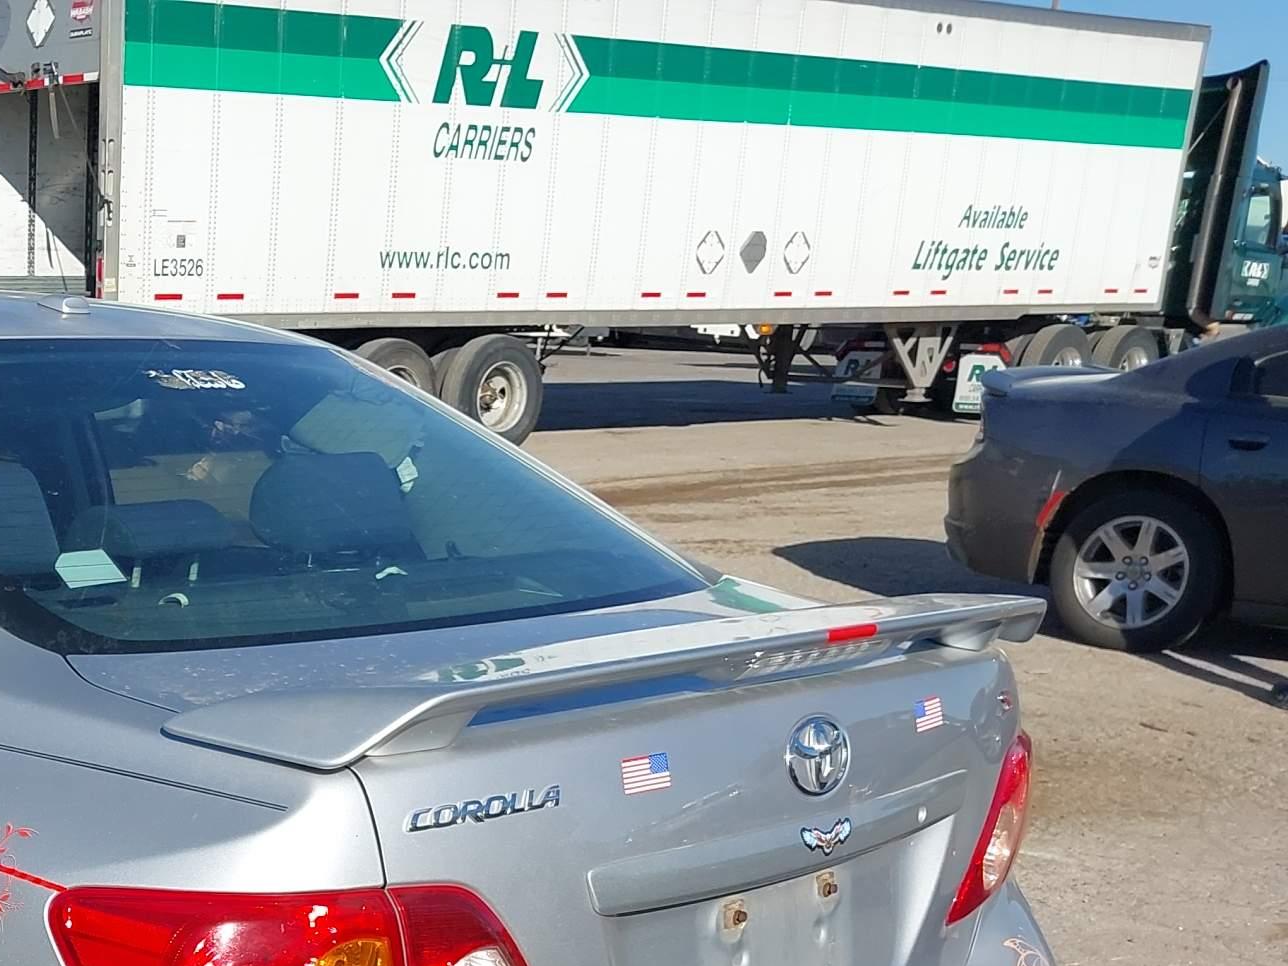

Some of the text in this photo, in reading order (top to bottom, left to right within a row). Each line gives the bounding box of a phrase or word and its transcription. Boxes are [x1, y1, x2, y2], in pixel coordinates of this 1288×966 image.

[433, 122, 536, 162] CARRIERS
[958, 204, 1029, 229] Available
[153, 258, 204, 277] LE3526
[379, 246, 511, 270] www.rlc.com
[911, 240, 1060, 281] Liftgate Service
[403, 784, 560, 832] COROLLA
